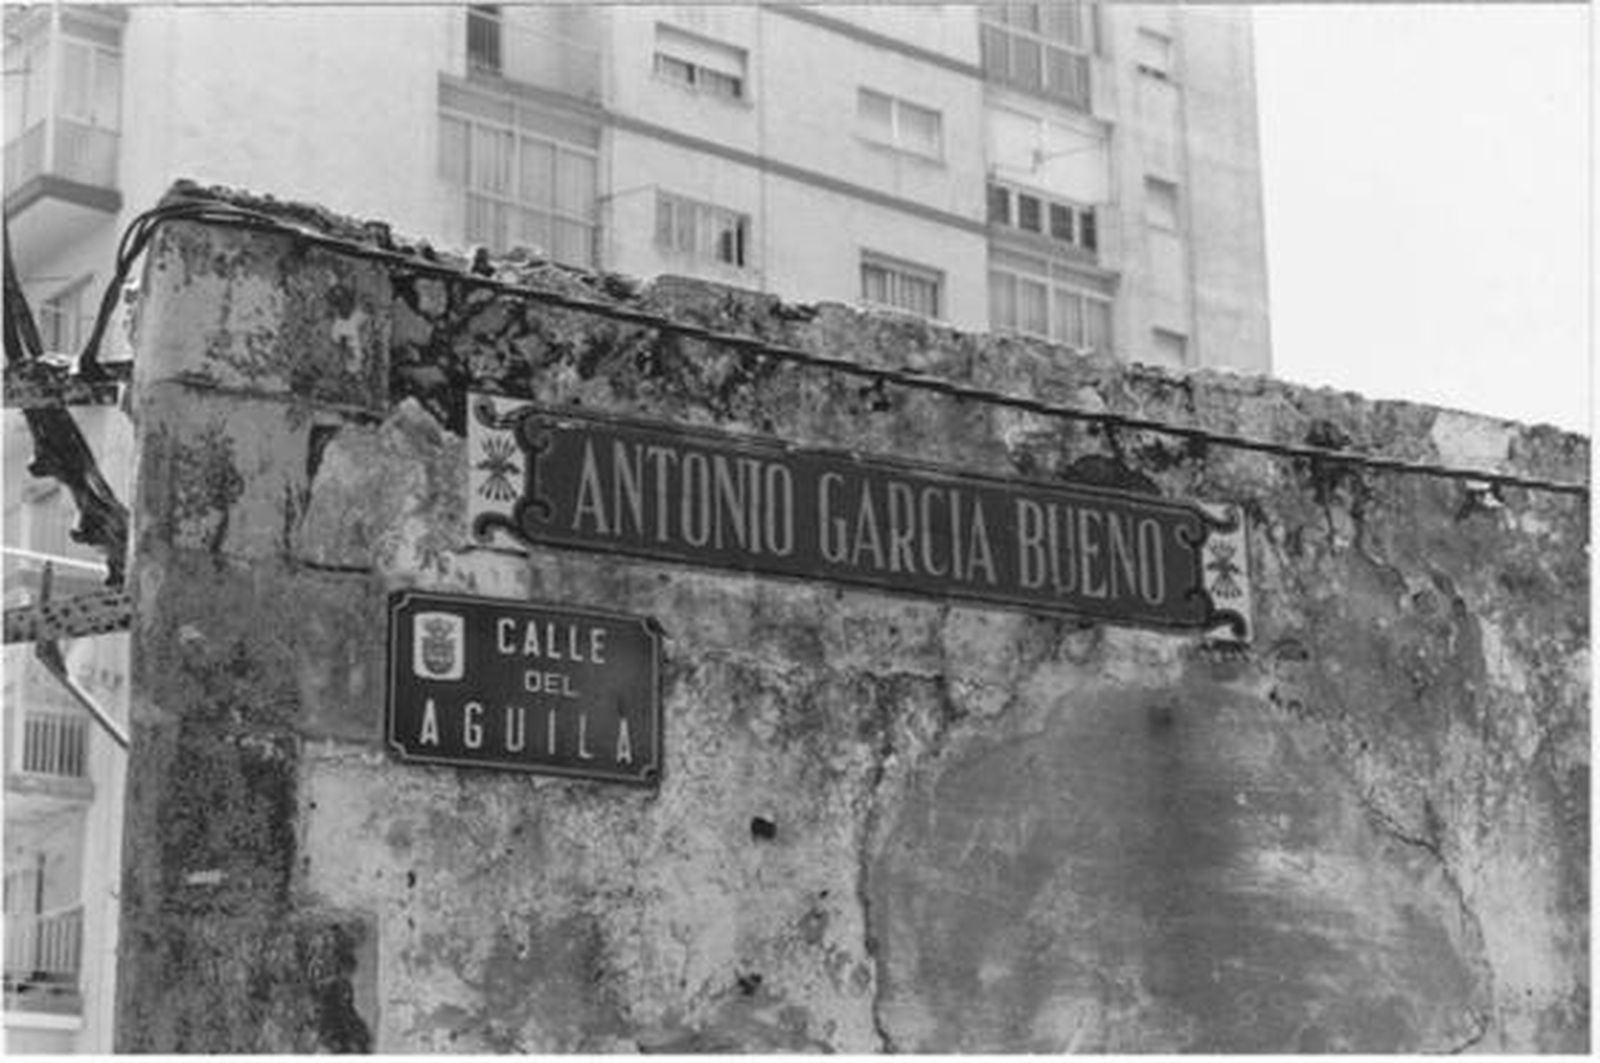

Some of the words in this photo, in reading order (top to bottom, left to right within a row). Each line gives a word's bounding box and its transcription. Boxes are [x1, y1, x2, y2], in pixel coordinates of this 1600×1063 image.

[572, 437, 794, 557] ANTONIO
[819, 471, 996, 585] GARCIA
[1016, 498, 1166, 606] BUENO
[498, 617, 606, 664] CALLE
[524, 669, 578, 698] DEL
[420, 698, 633, 765] AGUILA
